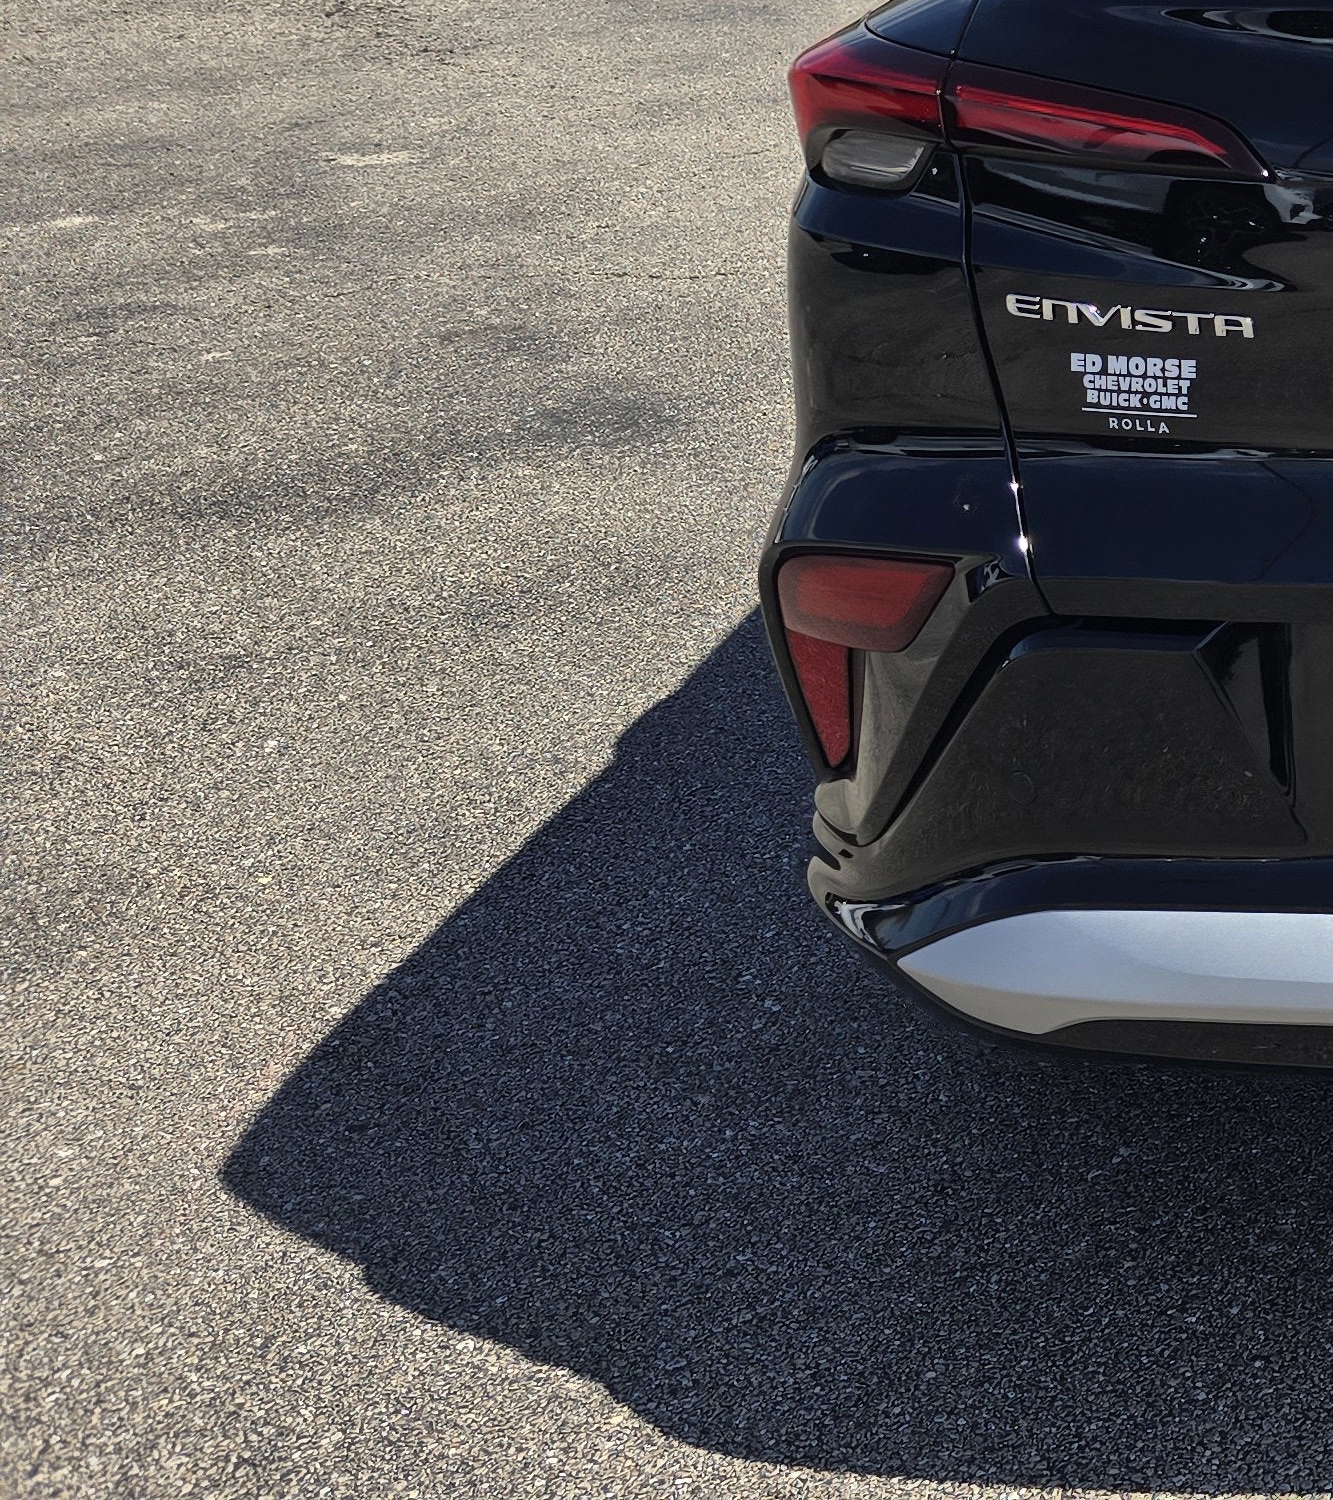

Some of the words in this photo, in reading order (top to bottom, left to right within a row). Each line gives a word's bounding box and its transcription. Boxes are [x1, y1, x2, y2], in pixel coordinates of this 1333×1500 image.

[1006, 293, 1255, 339] ENVISTA
[1070, 352, 1103, 373] ED
[1107, 355, 1198, 379] MORSE
[1082, 374, 1191, 395] CHEVROLET
[1108, 417, 1171, 434] ROLLA
